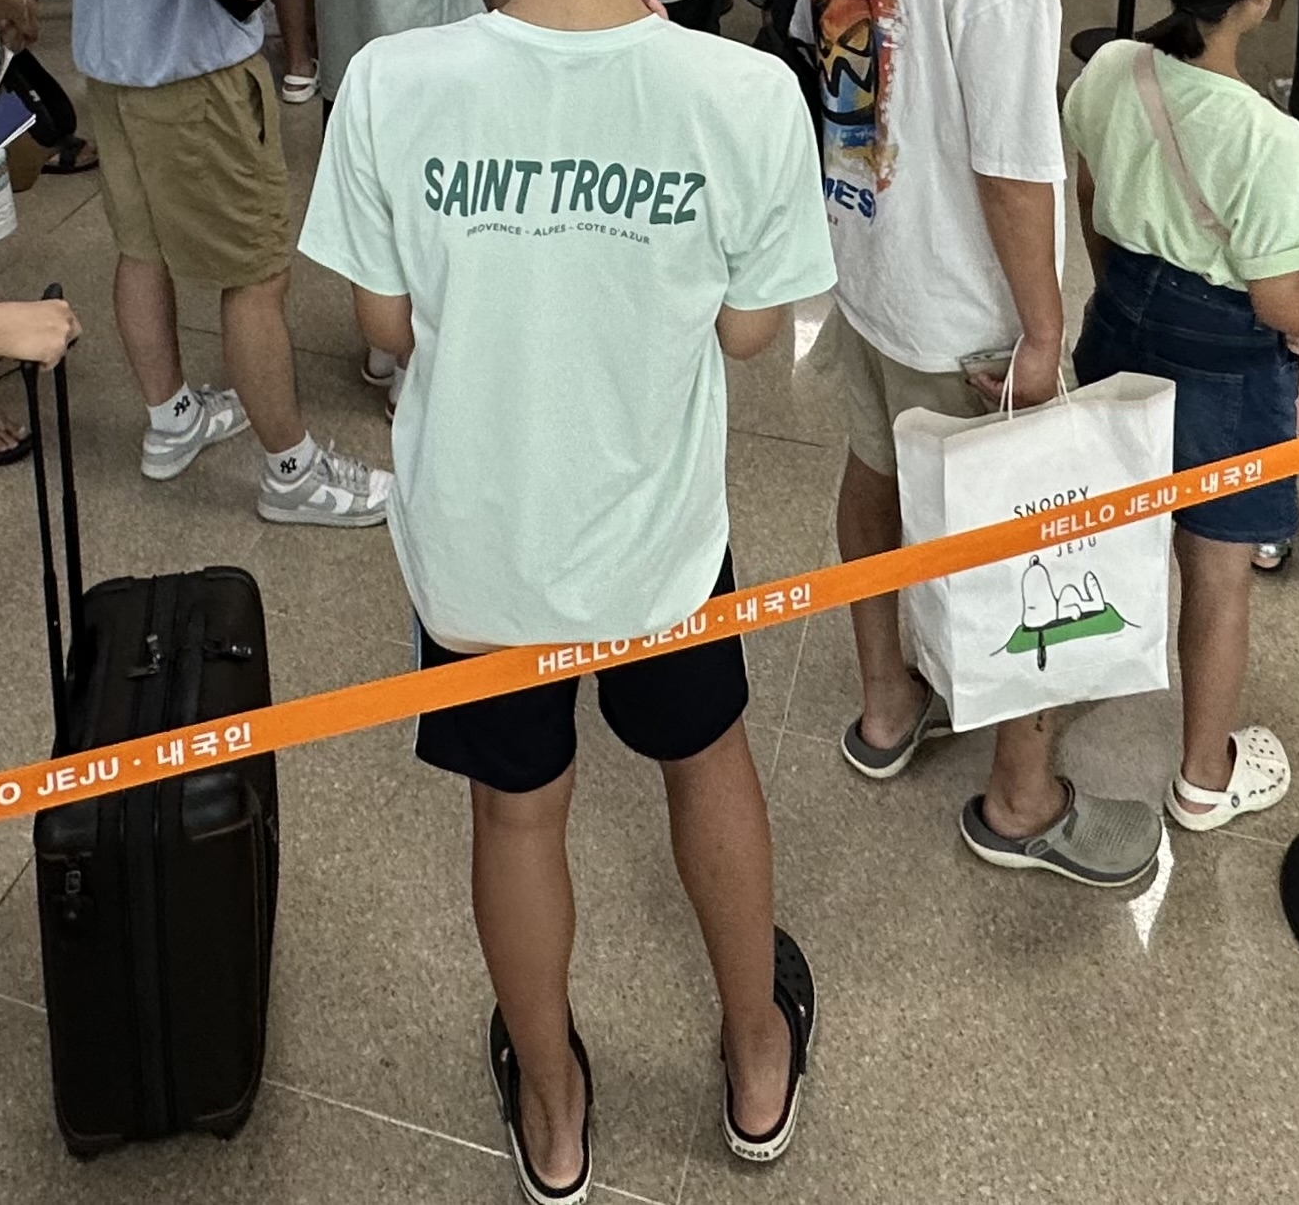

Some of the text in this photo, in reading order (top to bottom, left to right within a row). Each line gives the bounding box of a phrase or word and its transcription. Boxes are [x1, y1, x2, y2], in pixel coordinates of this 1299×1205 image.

[424, 157, 706, 225] SAINT TROPEZ
[466, 222, 522, 237] PROVENCE
[533, 224, 566, 237] ALPES
[609, 226, 651, 245] D'AZUR
[1012, 486, 1090, 518] SNOOPY
[1041, 460, 1261, 540] HELLO JEJU 내국인
[1056, 536, 1098, 557] JEJU
[538, 584, 810, 675] HELLO JEJU 내국인
[38, 757, 118, 795] JEJU
[157, 723, 251, 766] 내국인
